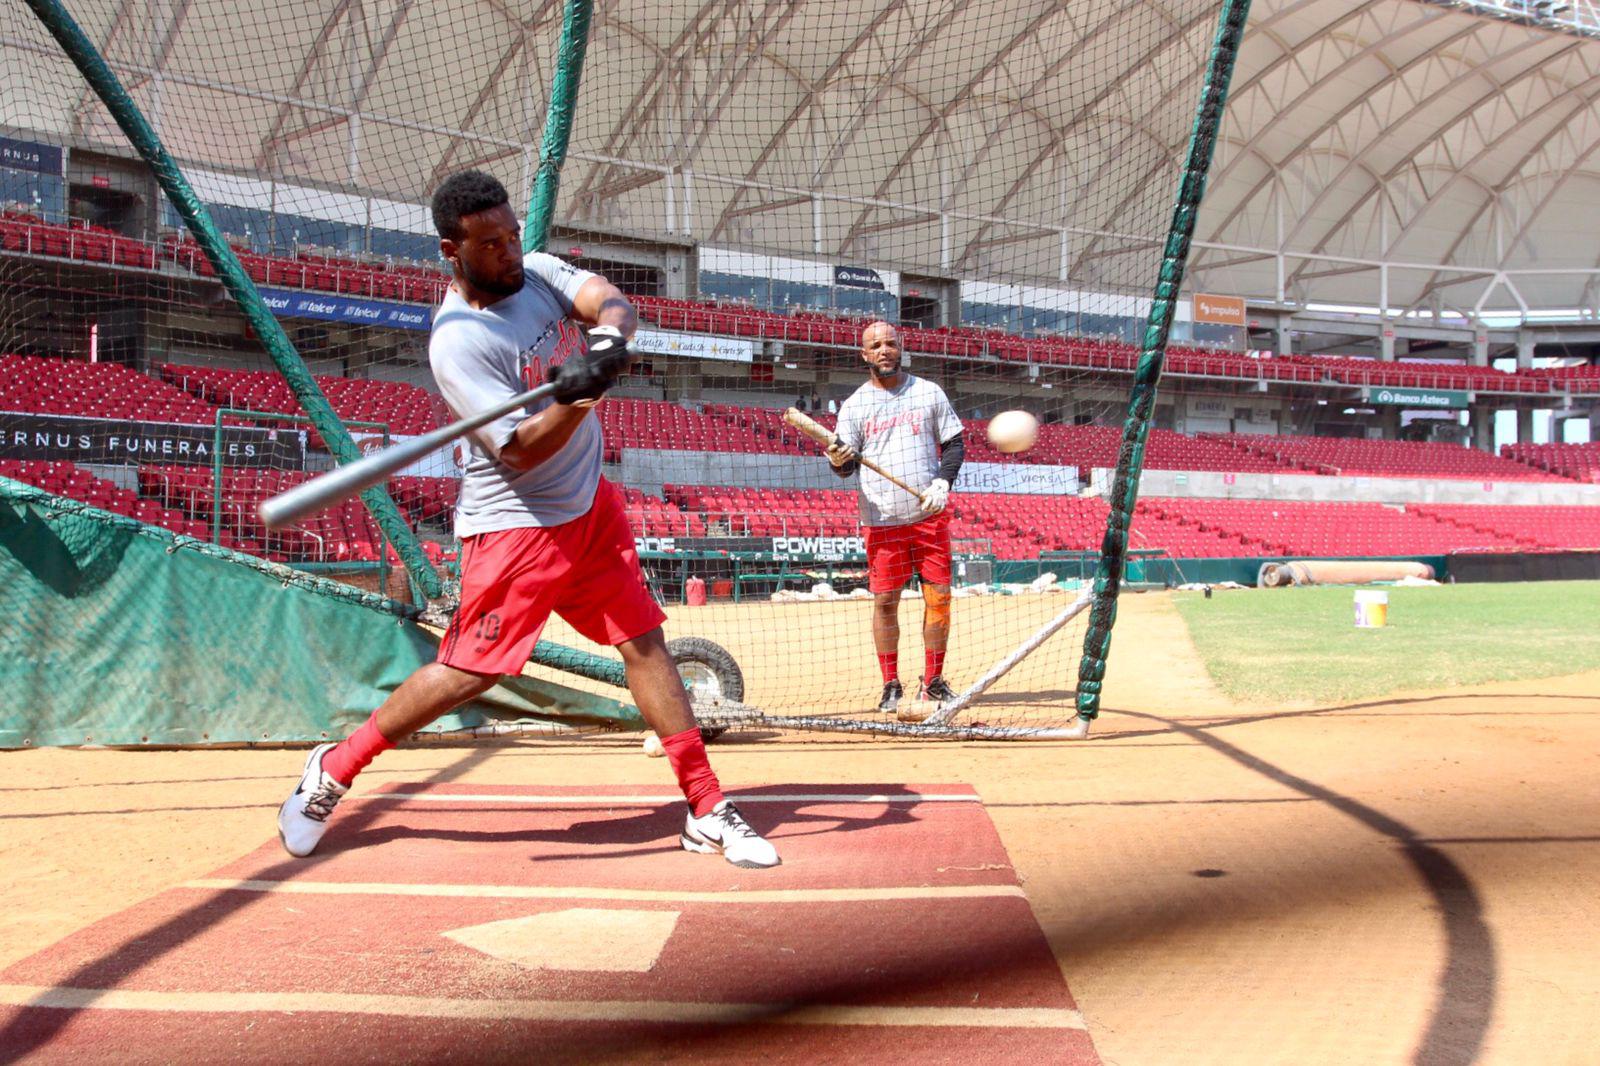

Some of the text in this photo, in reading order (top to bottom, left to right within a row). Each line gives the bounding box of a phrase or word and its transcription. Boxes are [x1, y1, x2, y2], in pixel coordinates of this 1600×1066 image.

[308, 302, 336, 314] telcel
[354, 306, 381, 319] telcel
[1394, 393, 1449, 405] Banco Azteca
[475, 611, 500, 641] 10
